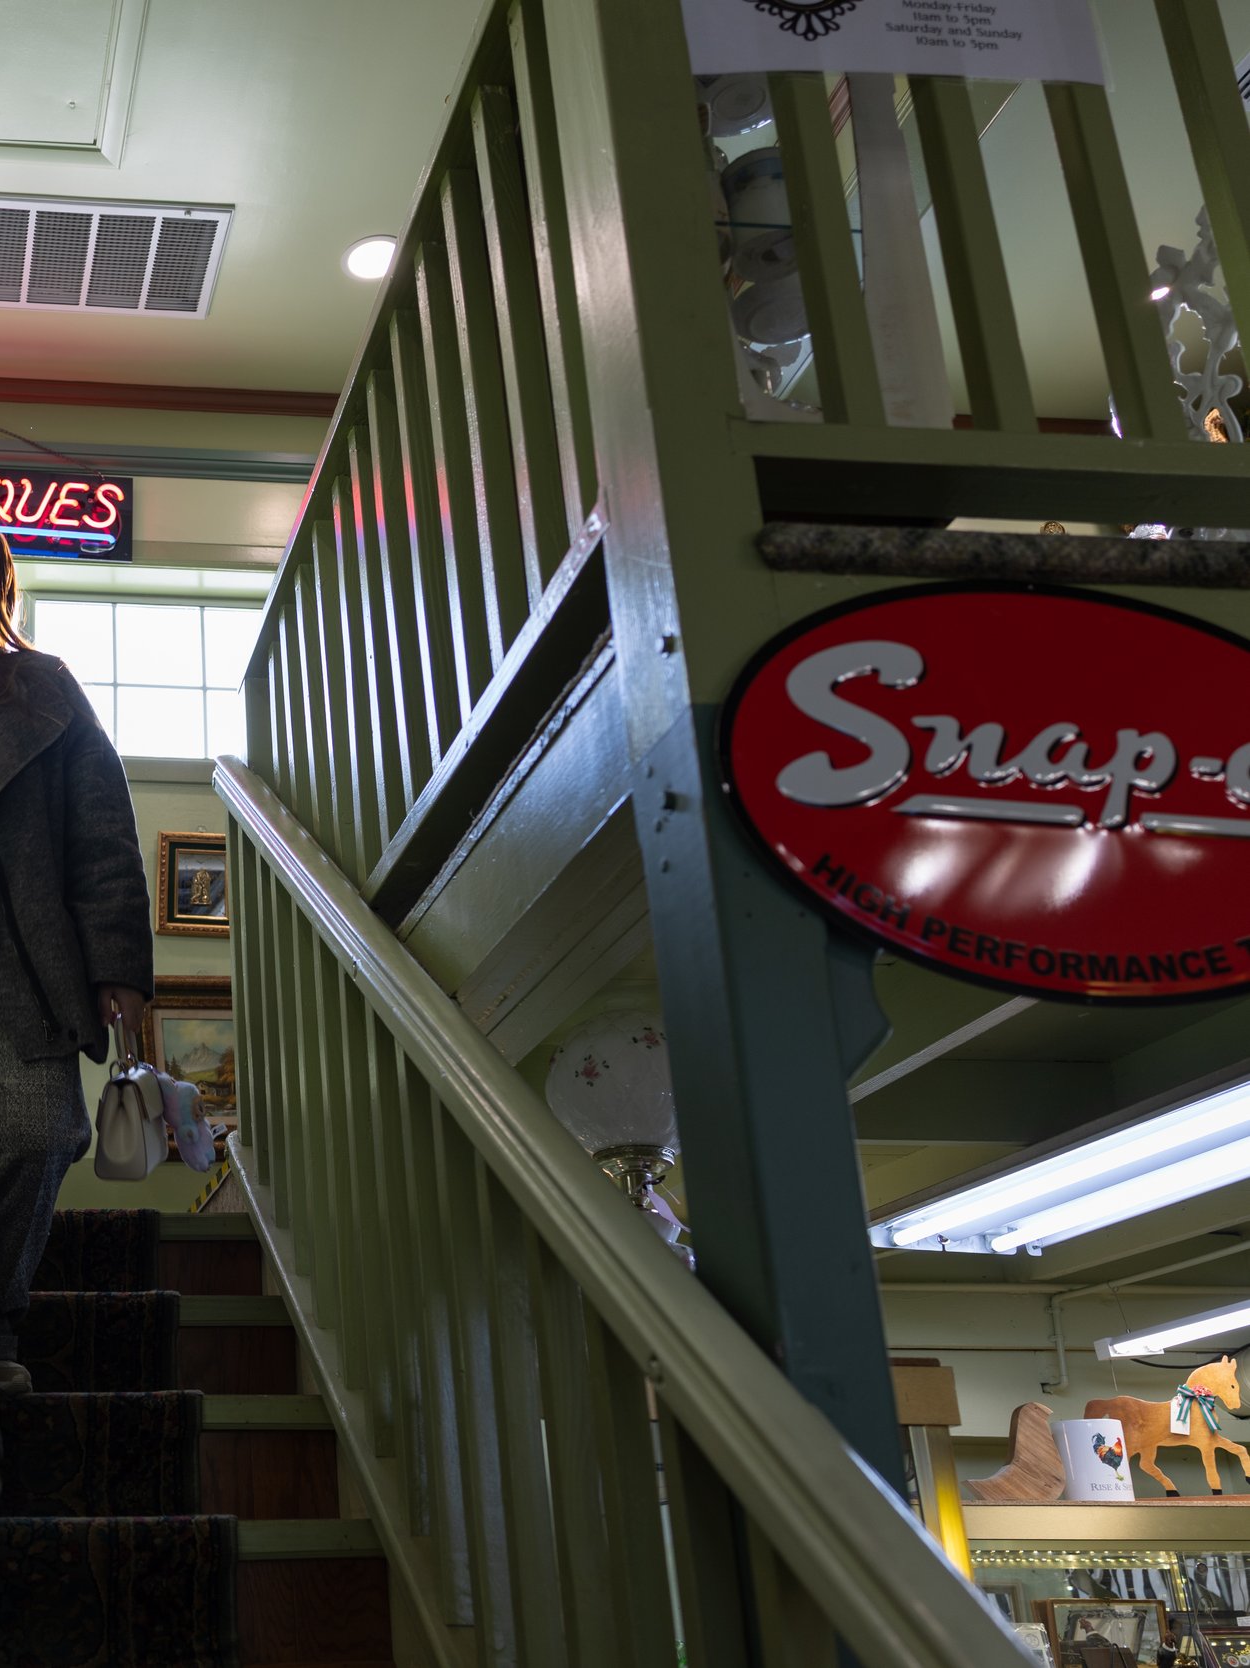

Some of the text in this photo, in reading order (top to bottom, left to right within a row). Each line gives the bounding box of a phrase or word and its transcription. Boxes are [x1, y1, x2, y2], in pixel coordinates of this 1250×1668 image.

[945, 14, 959, 23] to
[963, 15, 992, 26] 5pm
[885, 22, 1022, 41] Saturday and Sunday
[916, 36, 999, 51] 10am to 5pm
[810, 853, 912, 932] HIGH
[921, 913, 1233, 986] PERFORMANCE
